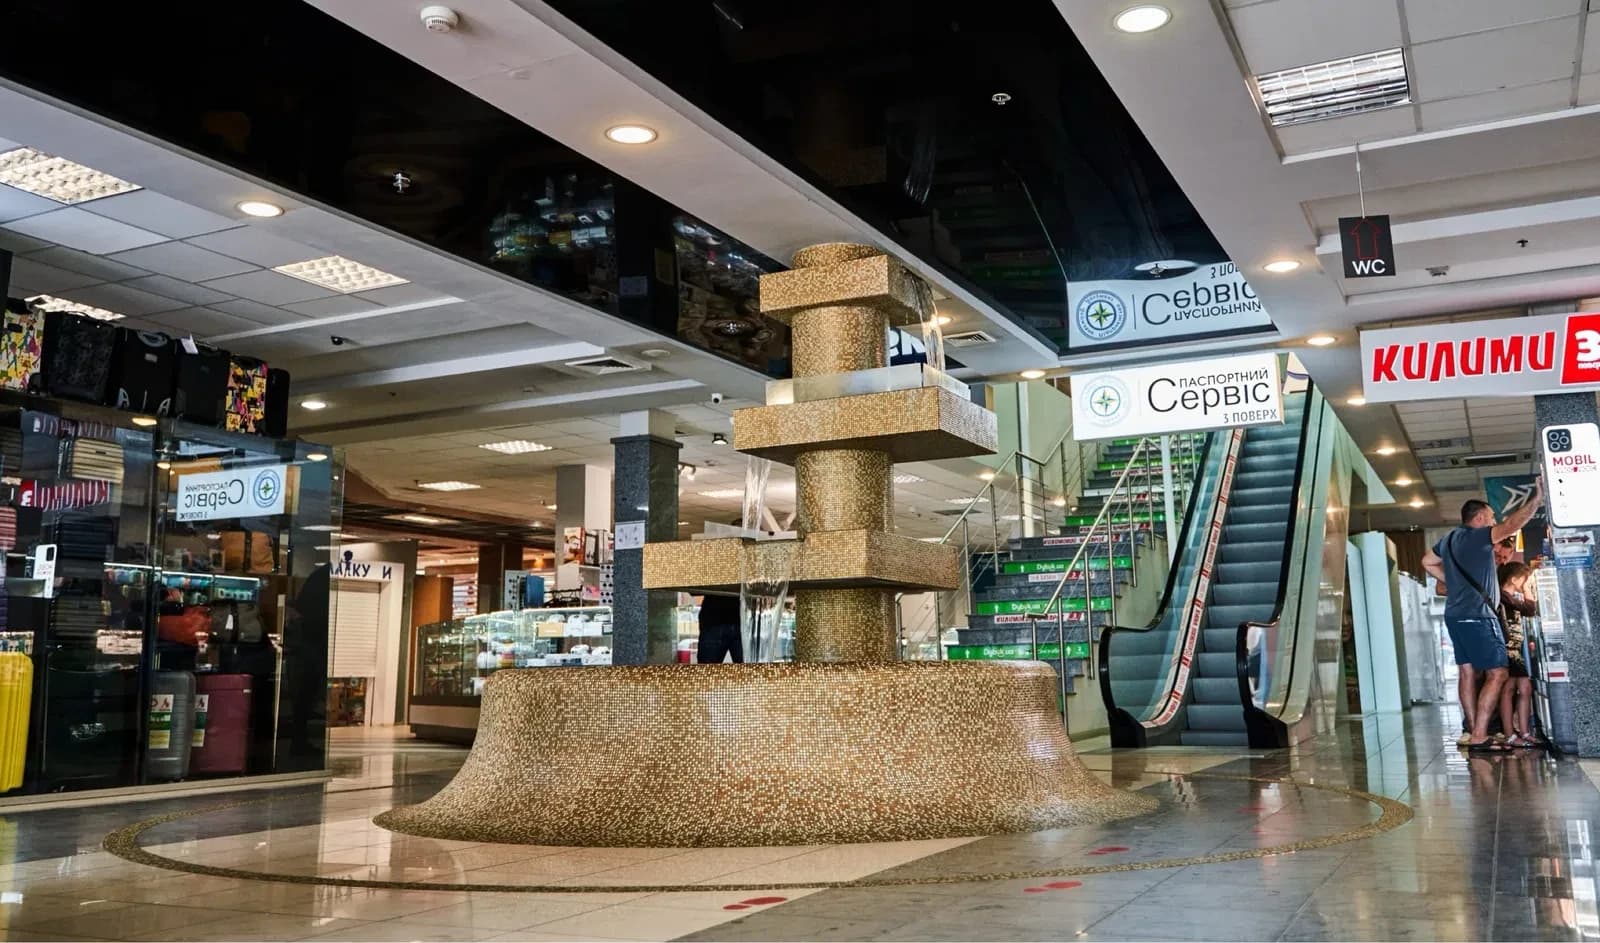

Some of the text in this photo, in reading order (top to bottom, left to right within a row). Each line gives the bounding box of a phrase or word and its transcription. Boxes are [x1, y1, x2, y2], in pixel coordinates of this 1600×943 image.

[1352, 259, 1386, 275] WC
[1179, 368, 1269, 388] ПАСПОРТНИЙ
[1223, 408, 1278, 424] 3 ПОВЕРХ
[1552, 454, 1597, 467] MOBIL
